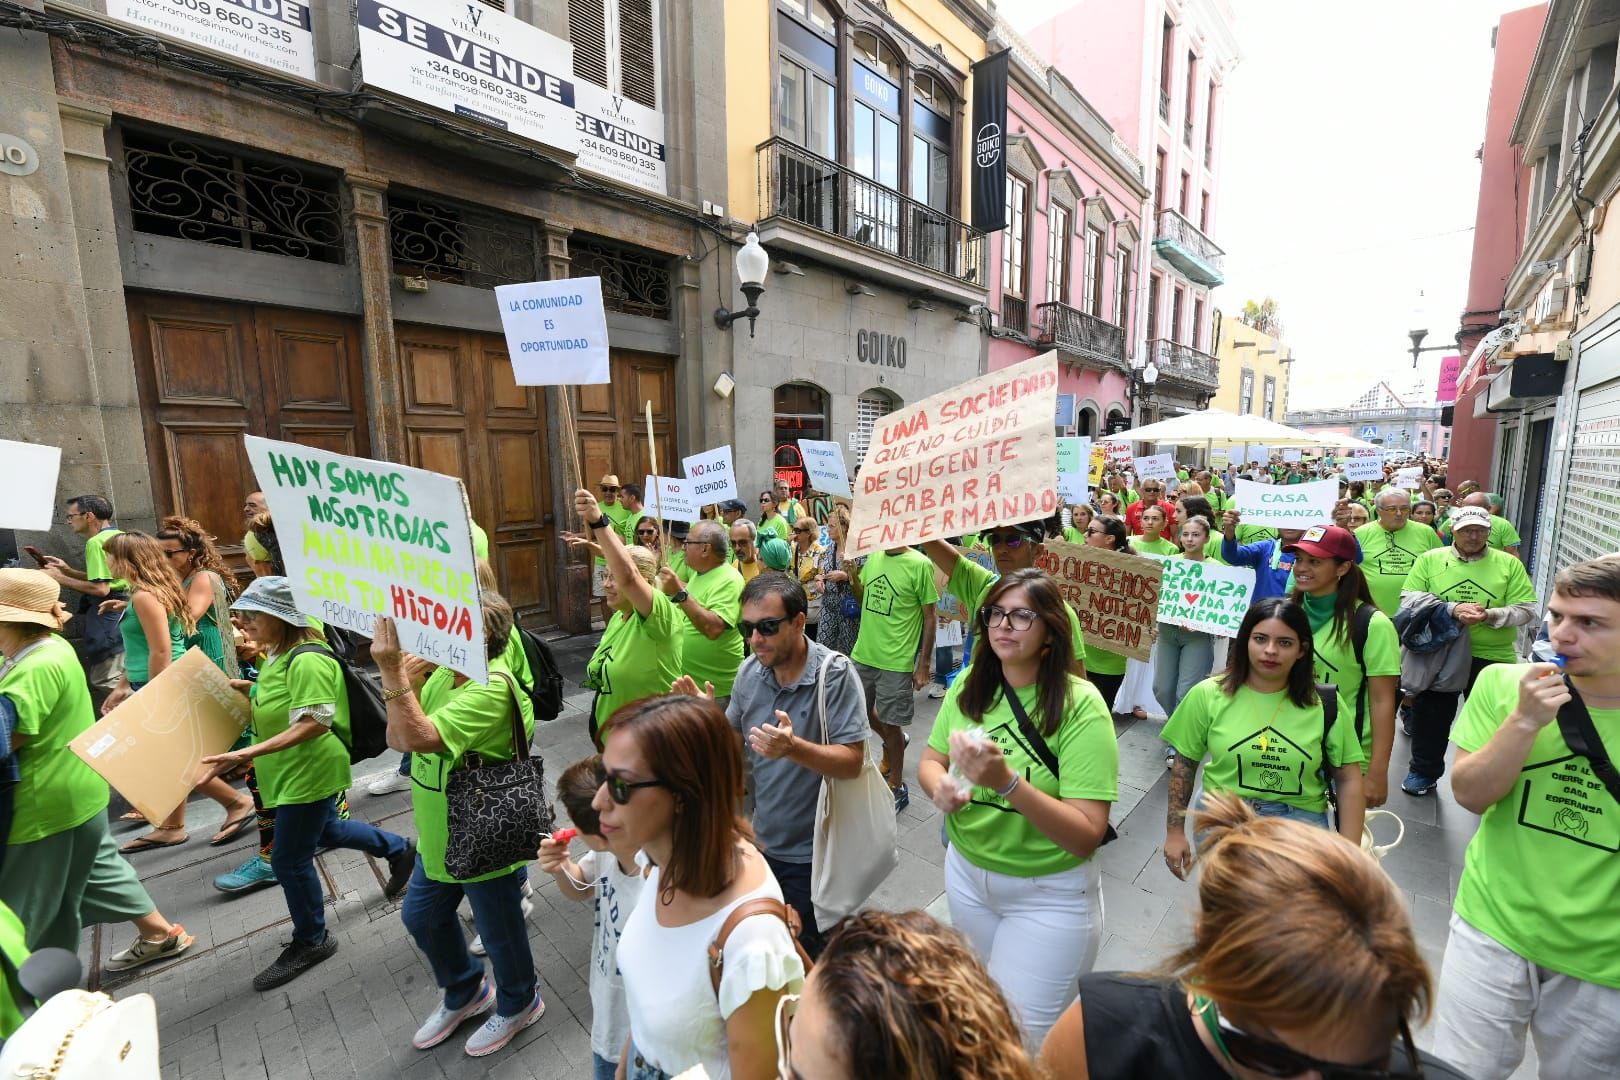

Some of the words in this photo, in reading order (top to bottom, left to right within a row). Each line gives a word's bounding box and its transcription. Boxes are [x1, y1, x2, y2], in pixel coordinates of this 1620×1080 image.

[216, 8, 253, 29] 660
[257, 22, 292, 44] 335
[451, 17, 500, 44] VILCHES
[126, 8, 185, 35] Hacemos
[191, 31, 239, 53] realidad
[243, 47, 260, 59] tus
[264, 52, 300, 73] sueños
[378, 7, 428, 48] SE
[444, 32, 562, 102] VENDE
[426, 60, 450, 75] +34
[453, 68, 477, 85] 609
[480, 79, 503, 95] 660
[506, 89, 527, 104] 335
[864, 74, 888, 102] GOIKO
[576, 112, 597, 137] SE
[600, 122, 661, 160] VENDE
[977, 137, 1000, 154] GOIKO
[580, 138, 597, 150] +34
[600, 144, 618, 157] 609
[640, 158, 656, 171] 335
[510, 301, 520, 312] LA
[522, 294, 583, 310] COMUNIDAD
[544, 319, 554, 330] ES
[520, 338, 589, 353] OPORTUNIDAD
[857, 328, 907, 369] GOIKO
[882, 410, 929, 446] UNA
[940, 370, 1056, 425] SOCIEDAD
[873, 440, 916, 465] QUE
[916, 433, 945, 455] NO
[953, 409, 1019, 442] CUIDA
[268, 451, 322, 489] HOY
[326, 461, 410, 507] SOMOS
[691, 464, 705, 477] NO
[712, 460, 726, 472] LOS
[864, 471, 890, 495] DE
[895, 461, 922, 490] SU
[928, 436, 1022, 478] GENTE
[667, 485, 680, 493] NO
[694, 479, 728, 495] DESPIDOS
[879, 466, 1005, 520] ACABARÁ
[1261, 493, 1309, 503] CASA
[856, 489, 1056, 551] ENFERMANDO
[1240, 507, 1324, 518] ESPERANZA
[301, 520, 398, 579] MAÑANA
[400, 552, 475, 606] PUEDE
[1163, 559, 1203, 578] ASA
[305, 566, 349, 604] SER
[352, 579, 385, 613] TU
[1063, 556, 1159, 604] QUEREMOS
[1161, 573, 1247, 598] PERANZA
[1059, 584, 1082, 605] ER
[322, 600, 377, 633] PROMOC
[1251, 761, 1291, 772] ESPERANZA
[1261, 754, 1281, 762] CASA
[1564, 763, 1577, 772] NO
[1551, 772, 1584, 786] CIERRE
[1587, 781, 1601, 790] DE
[1563, 786, 1588, 799] CASA
[1545, 794, 1603, 815] ESPERANZA
